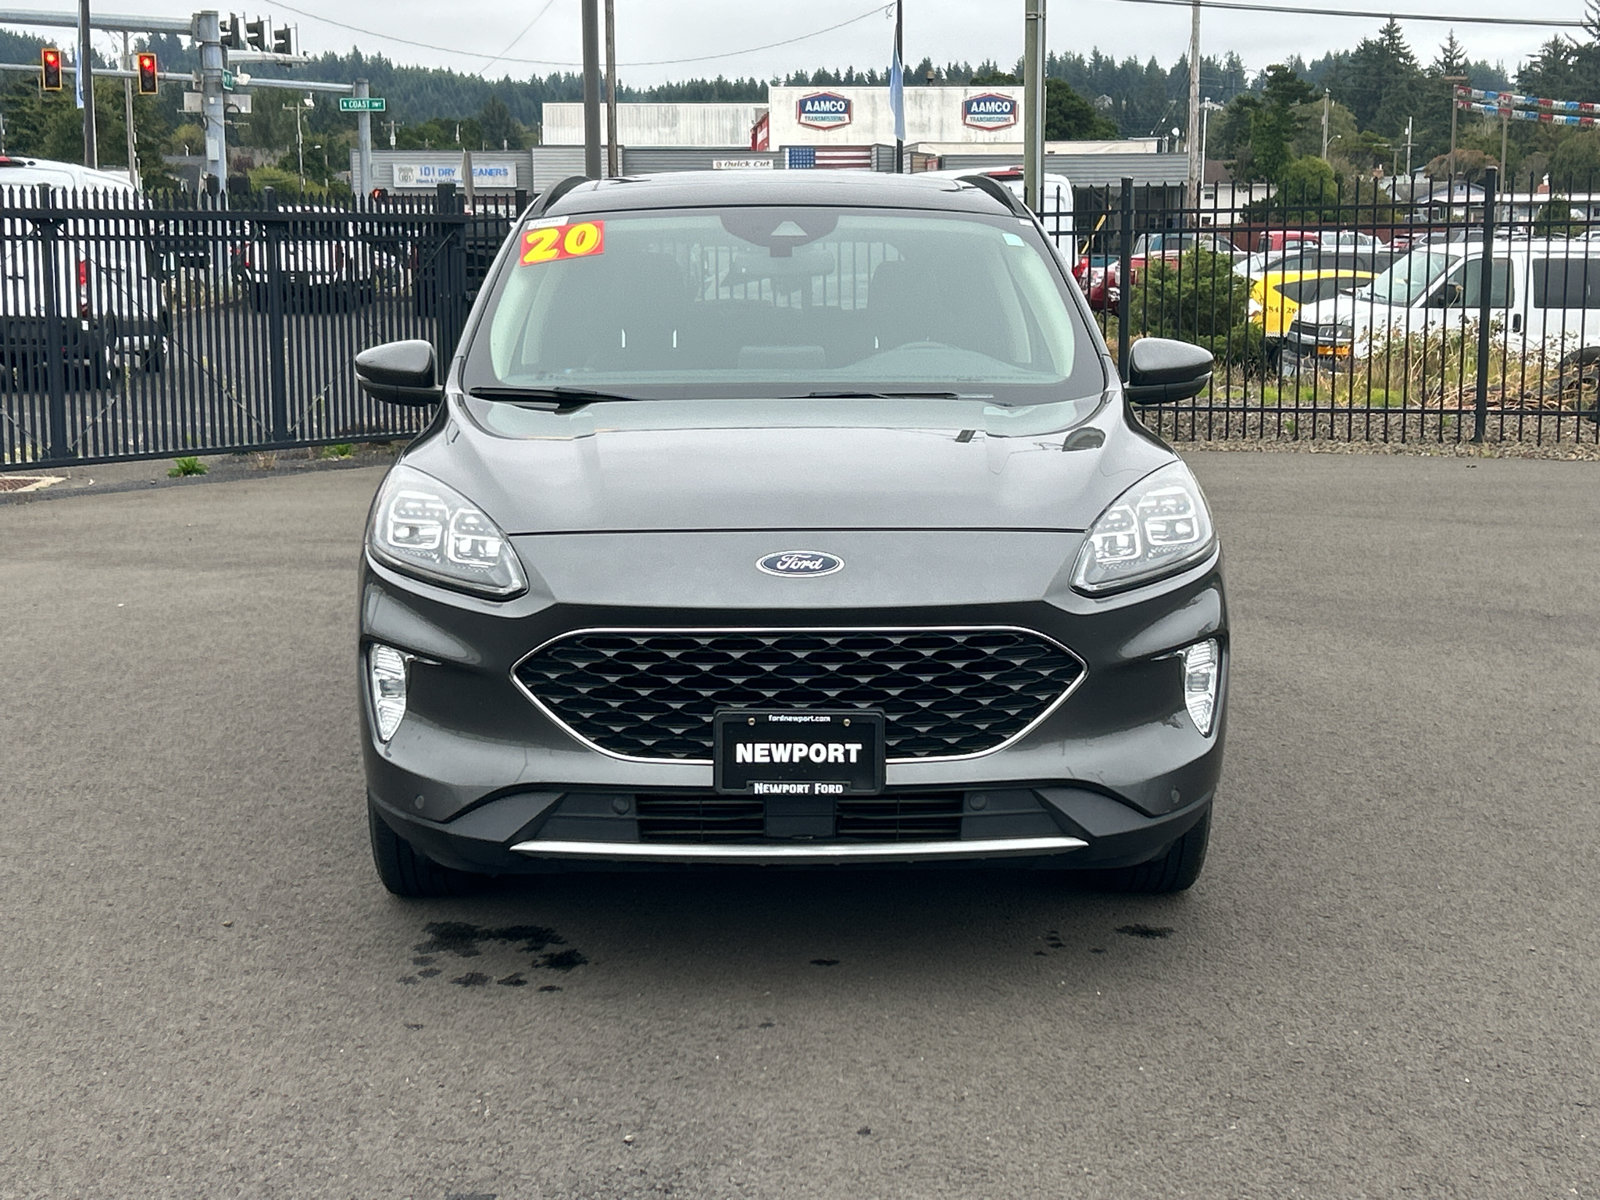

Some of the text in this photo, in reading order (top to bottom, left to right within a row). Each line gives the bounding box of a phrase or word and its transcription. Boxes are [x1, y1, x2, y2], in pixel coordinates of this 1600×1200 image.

[805, 101, 845, 112] AAMCO
[971, 102, 1010, 112] AAMCO
[420, 166, 435, 176] 101
[438, 168, 456, 176] DRY
[524, 223, 601, 263] 20
[776, 554, 824, 570] Ford
[736, 743, 862, 763] NEWPORT
